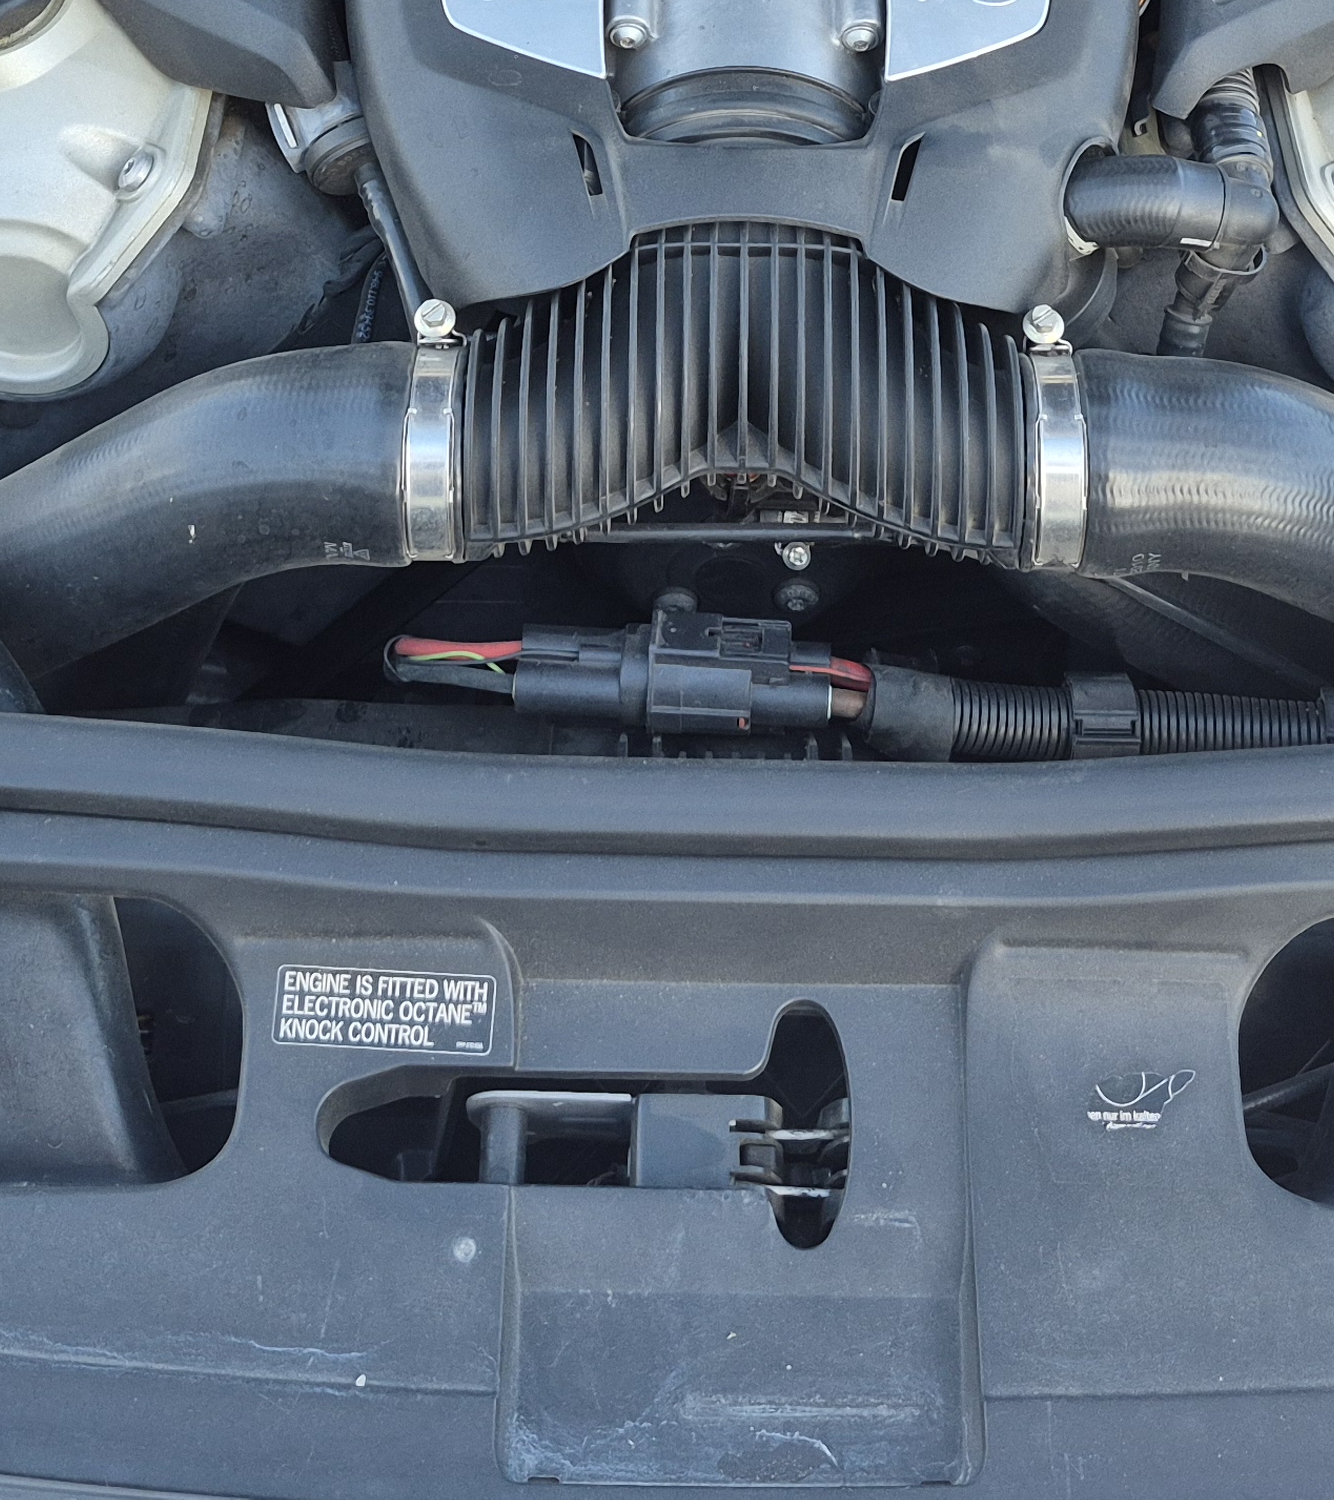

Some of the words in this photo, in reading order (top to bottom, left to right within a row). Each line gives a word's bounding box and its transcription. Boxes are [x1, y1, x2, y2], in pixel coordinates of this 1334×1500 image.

[284, 971, 351, 994] ENGINE
[356, 975, 373, 995] IS
[378, 977, 438, 999] FITTED
[443, 979, 489, 1001] WITH
[282, 994, 394, 1020] ELECTRONIC
[279, 1018, 344, 1041] KNOCK
[348, 1022, 434, 1047] CONTROL
